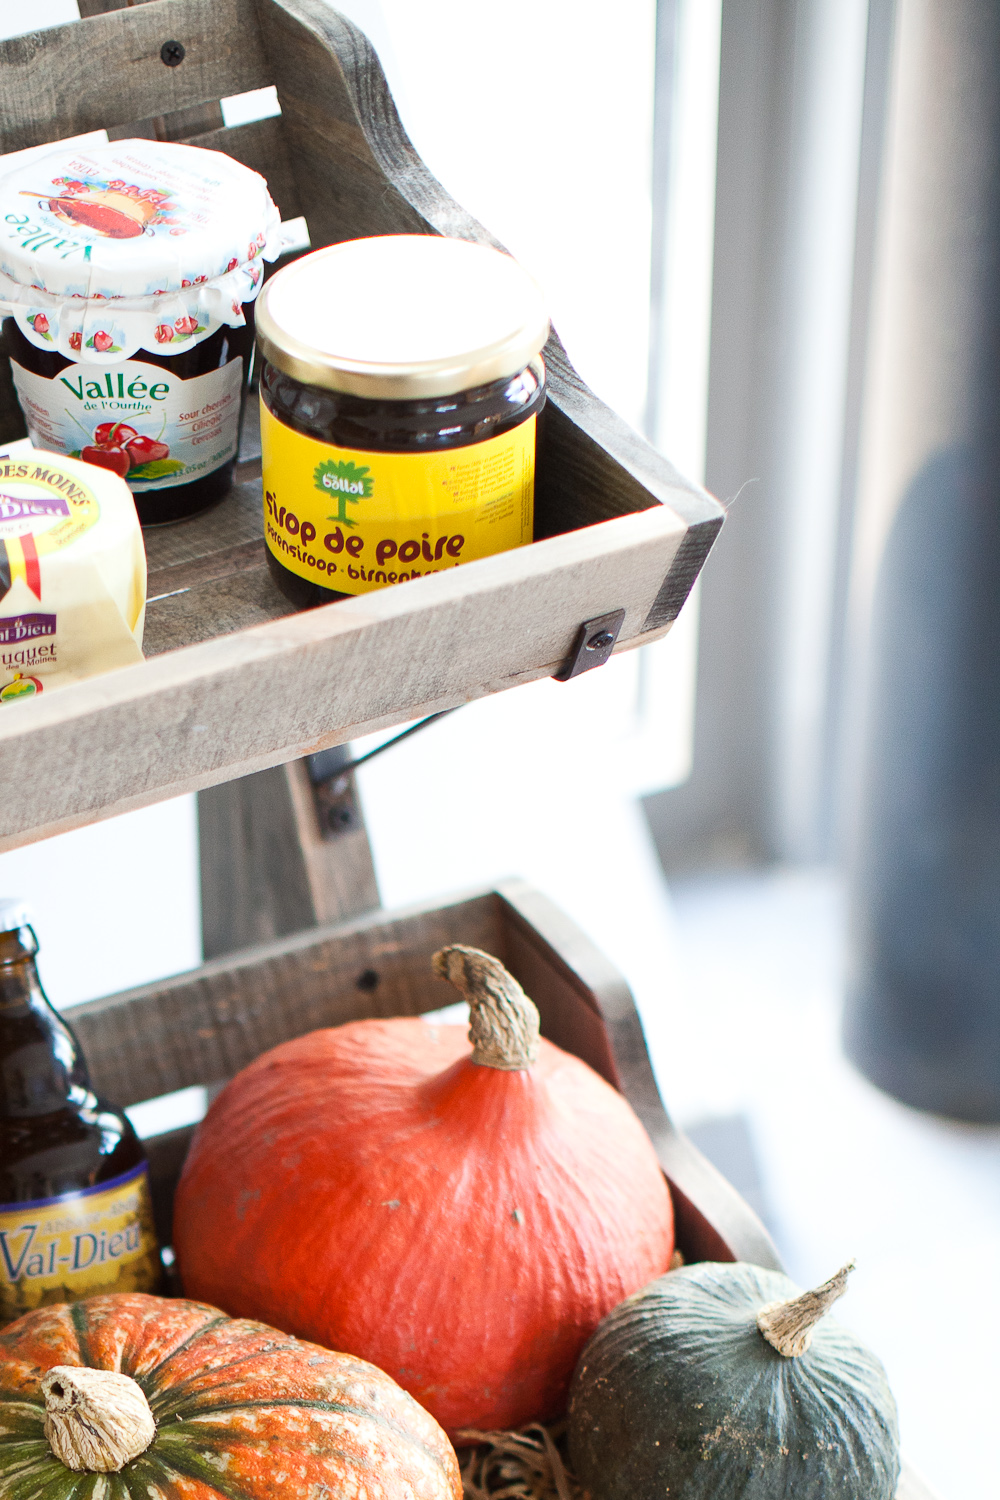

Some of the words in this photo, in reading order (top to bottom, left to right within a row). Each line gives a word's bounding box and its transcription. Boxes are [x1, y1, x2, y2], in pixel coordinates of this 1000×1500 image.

[5, 212, 93, 262] Vallée
[60, 372, 170, 402] Vallée
[84, 401, 99, 411] de
[101, 400, 153, 412] l'Ourthe
[179, 409, 200, 421] Sour
[30, 467, 91, 507] MOINES
[265, 489, 317, 547] sirop
[324, 526, 364, 558] de
[375, 533, 465, 566] poire
[266, 522, 338, 576] perensiroop
[26, 656, 57, 667] Moines
